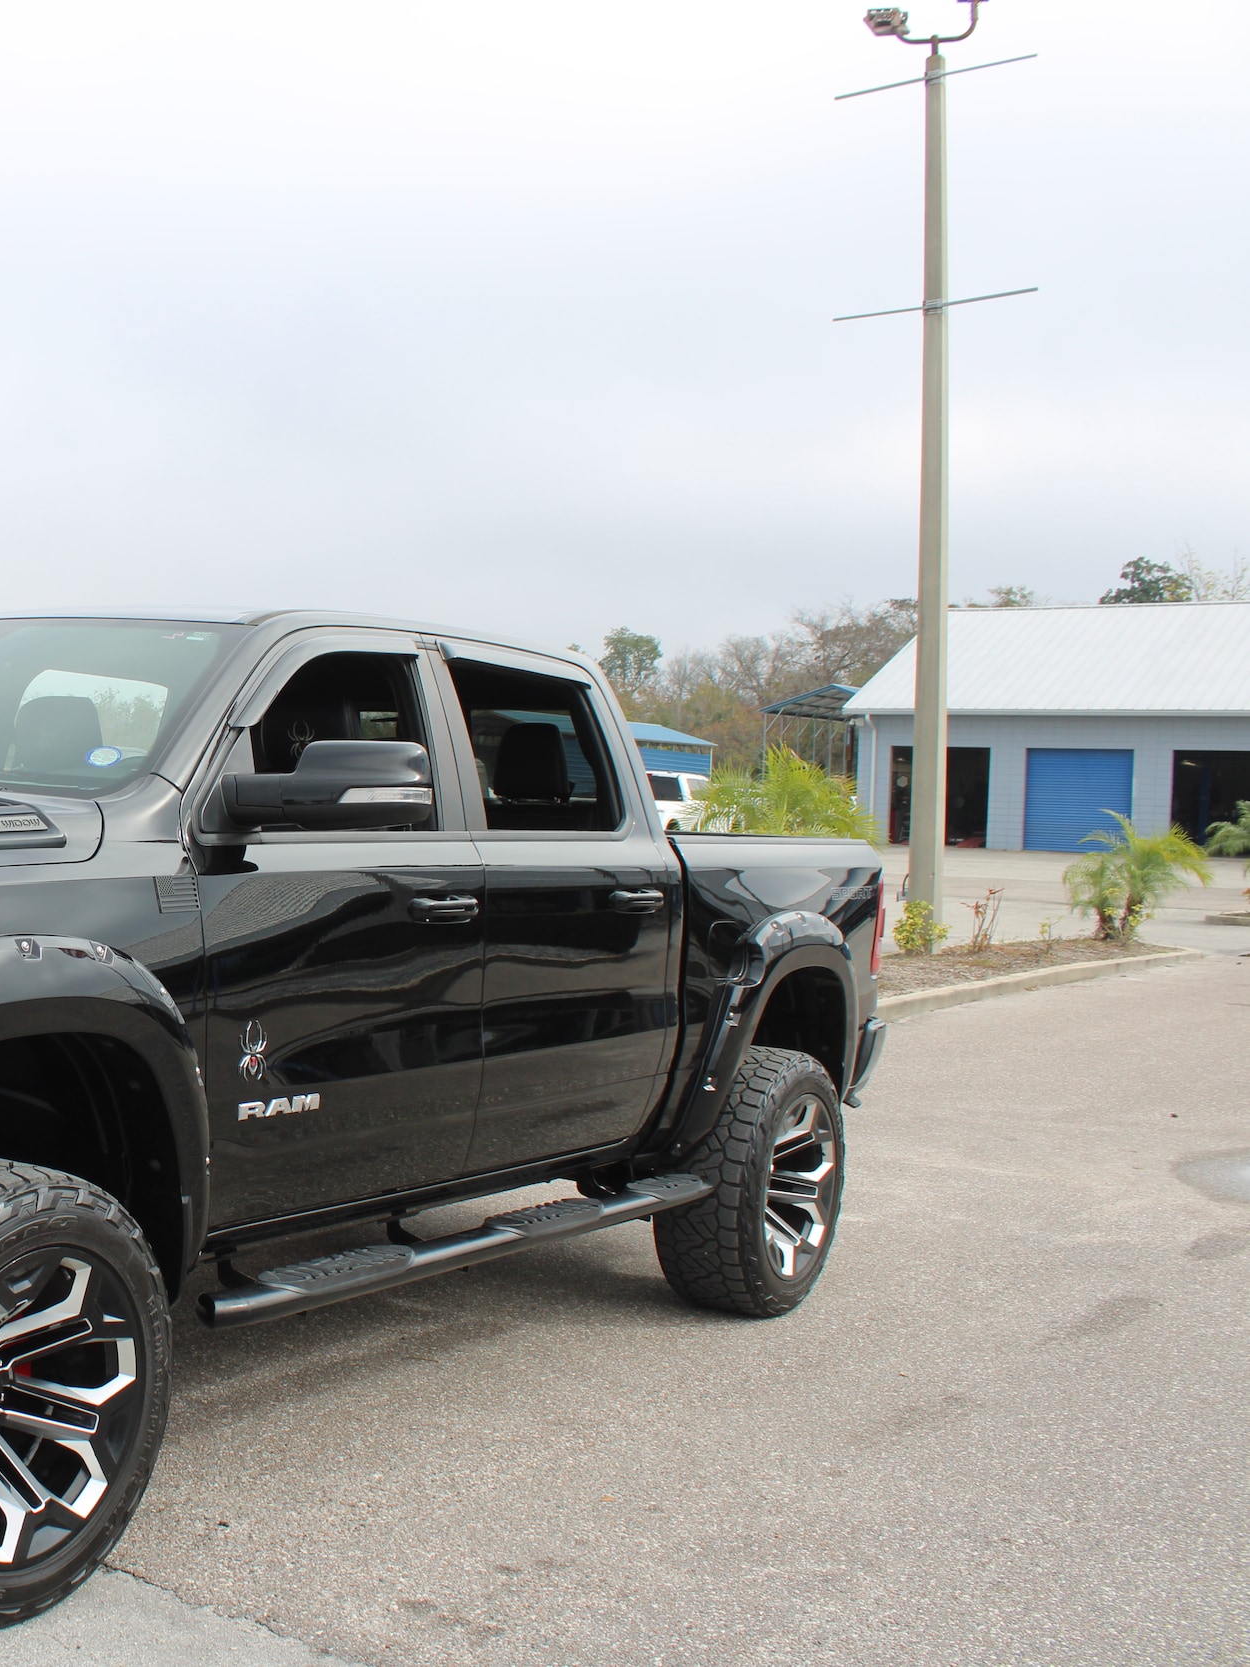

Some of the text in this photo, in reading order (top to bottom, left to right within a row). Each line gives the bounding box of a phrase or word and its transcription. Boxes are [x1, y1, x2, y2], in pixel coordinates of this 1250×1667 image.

[1, 818, 40, 828] WIDOW
[831, 885, 873, 900] SPORT
[237, 1092, 321, 1122] RAM
